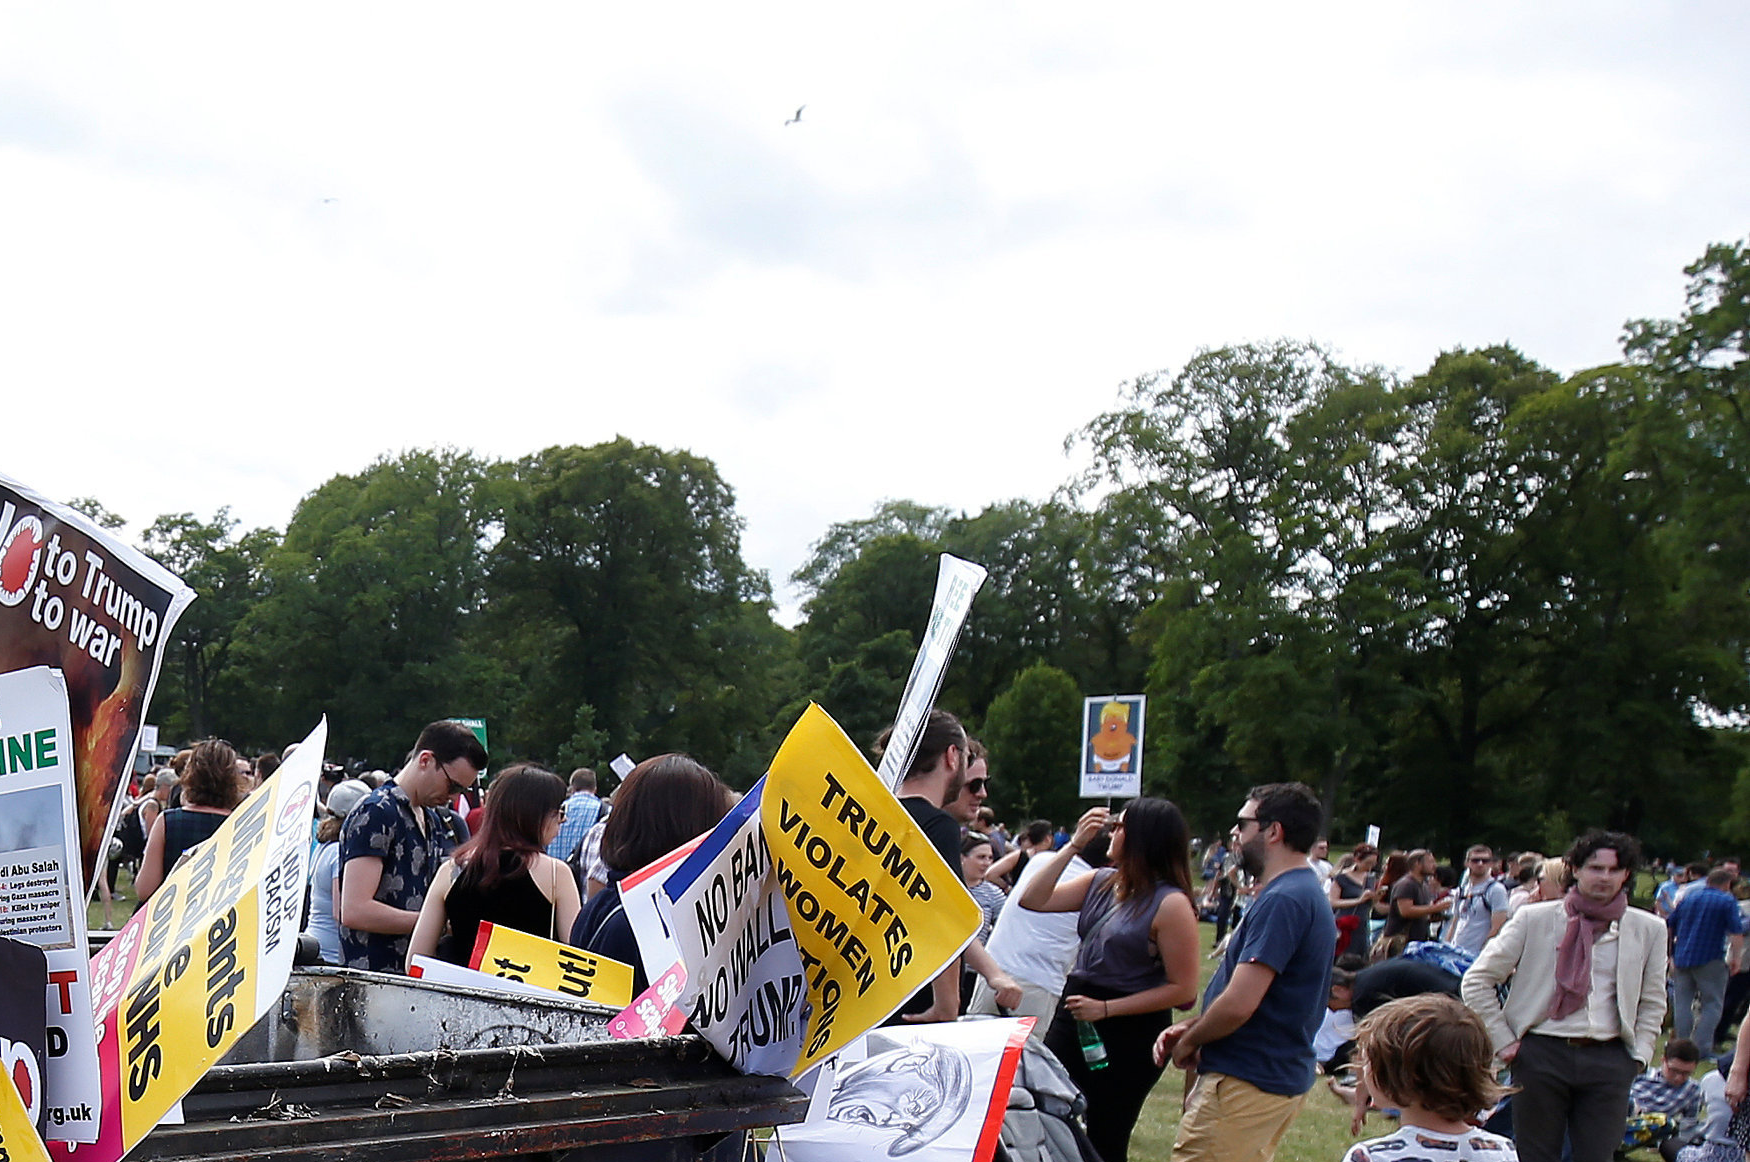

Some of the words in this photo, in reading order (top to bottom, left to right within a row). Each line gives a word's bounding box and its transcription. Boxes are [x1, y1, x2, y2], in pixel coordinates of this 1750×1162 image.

[31, 579, 65, 631] to
[69, 608, 122, 667] war
[44, 534, 78, 586] to
[82, 550, 158, 652] Trump
[11, 864, 30, 877] Abu
[31, 859, 59, 873] Salah
[819, 772, 933, 902] TRUMP
[10, 881, 25, 890] Legs
[26, 877, 58, 888] destroyed
[11, 893, 27, 901] Gaza
[28, 889, 59, 899] massacre
[11, 902, 30, 913] Killed
[31, 902, 39, 911] by
[40, 901, 60, 910] sniper
[16, 914, 47, 923] massacre
[140, 883, 177, 968] our
[163, 840, 219, 989] make
[205, 786, 272, 1049] Migrants
[264, 866, 281, 956] RACISM
[282, 897, 299, 921] UP
[694, 873, 729, 958] NO
[779, 798, 914, 979] VIOLATES
[28, 924, 62, 935] protestors
[776, 857, 876, 998] WOMEN
[126, 962, 162, 1102] NHS
[689, 965, 729, 1028] NO
